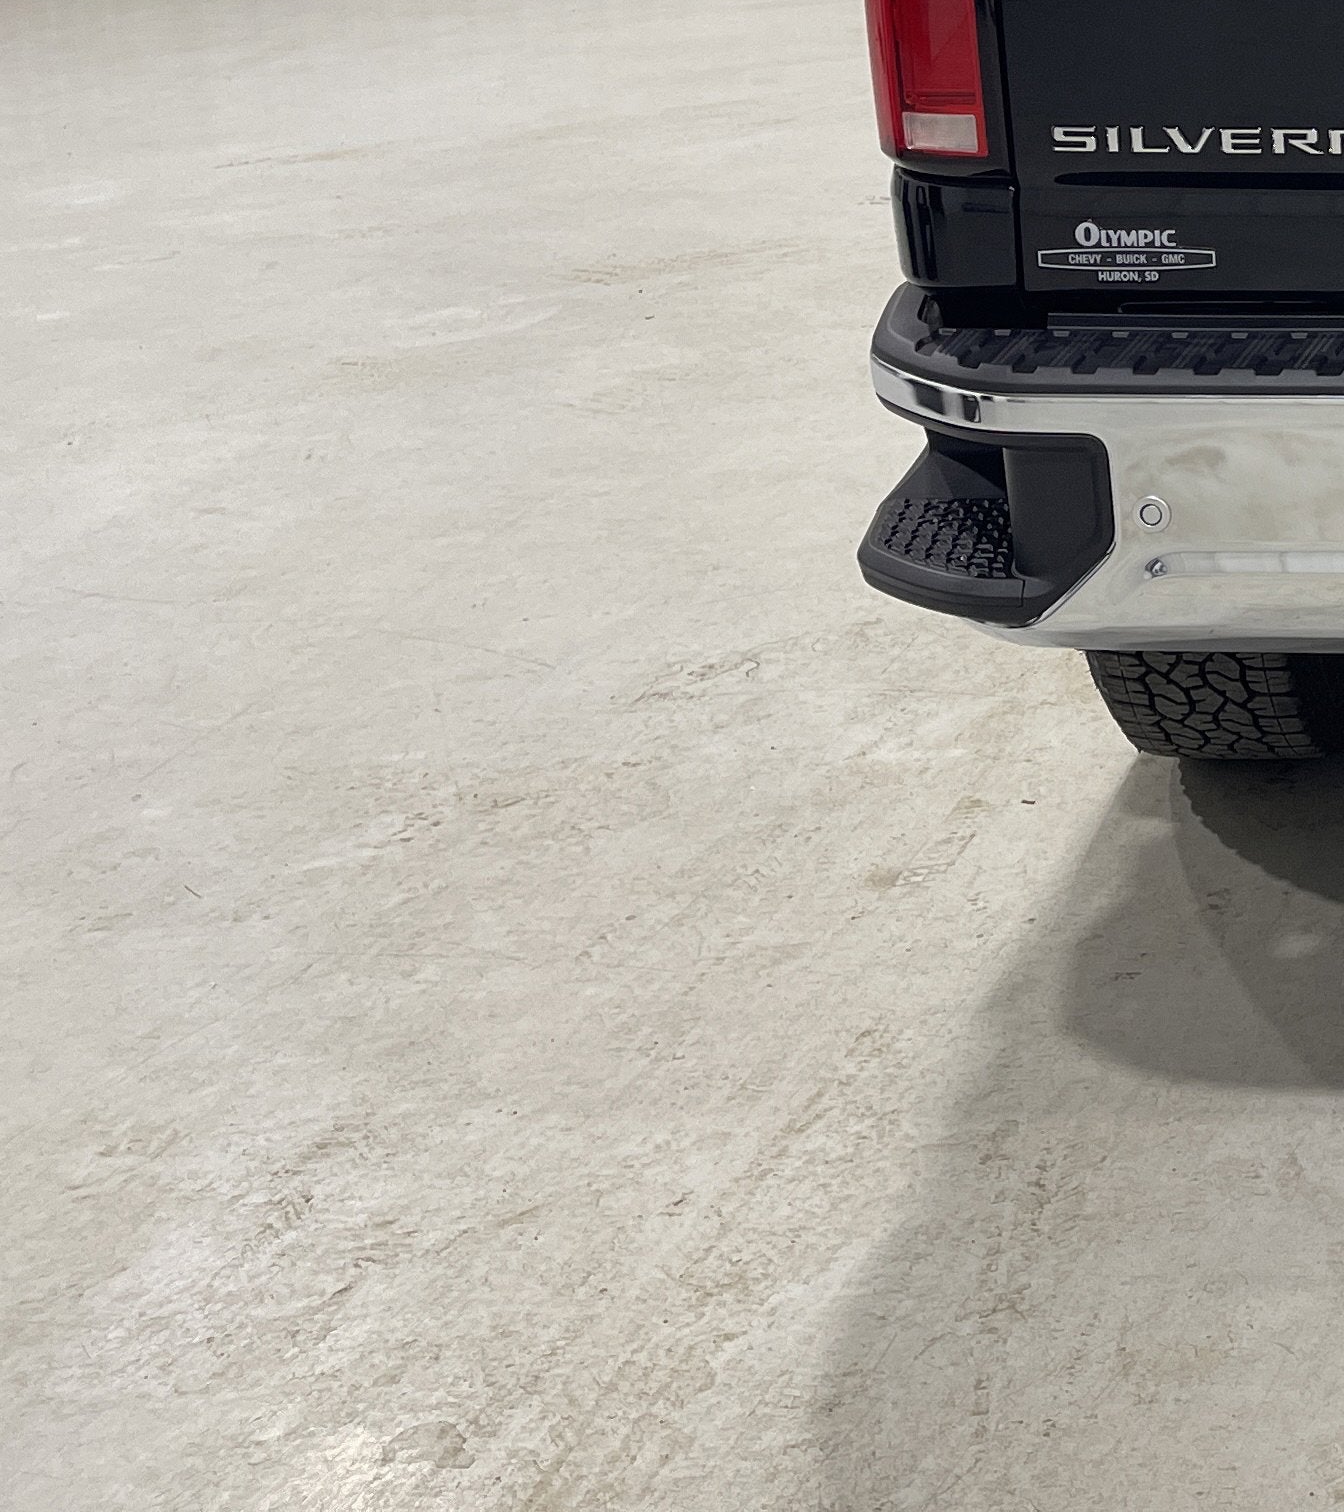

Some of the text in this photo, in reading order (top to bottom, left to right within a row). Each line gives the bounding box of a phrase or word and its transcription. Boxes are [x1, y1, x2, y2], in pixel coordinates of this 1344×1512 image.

[1074, 220, 1177, 247] OLYMPIC
[1068, 254, 1102, 264] CHEVY
[1116, 254, 1148, 264] BUICK
[1161, 254, 1185, 264] GMC
[1098, 271, 1159, 283] HURON, SD
